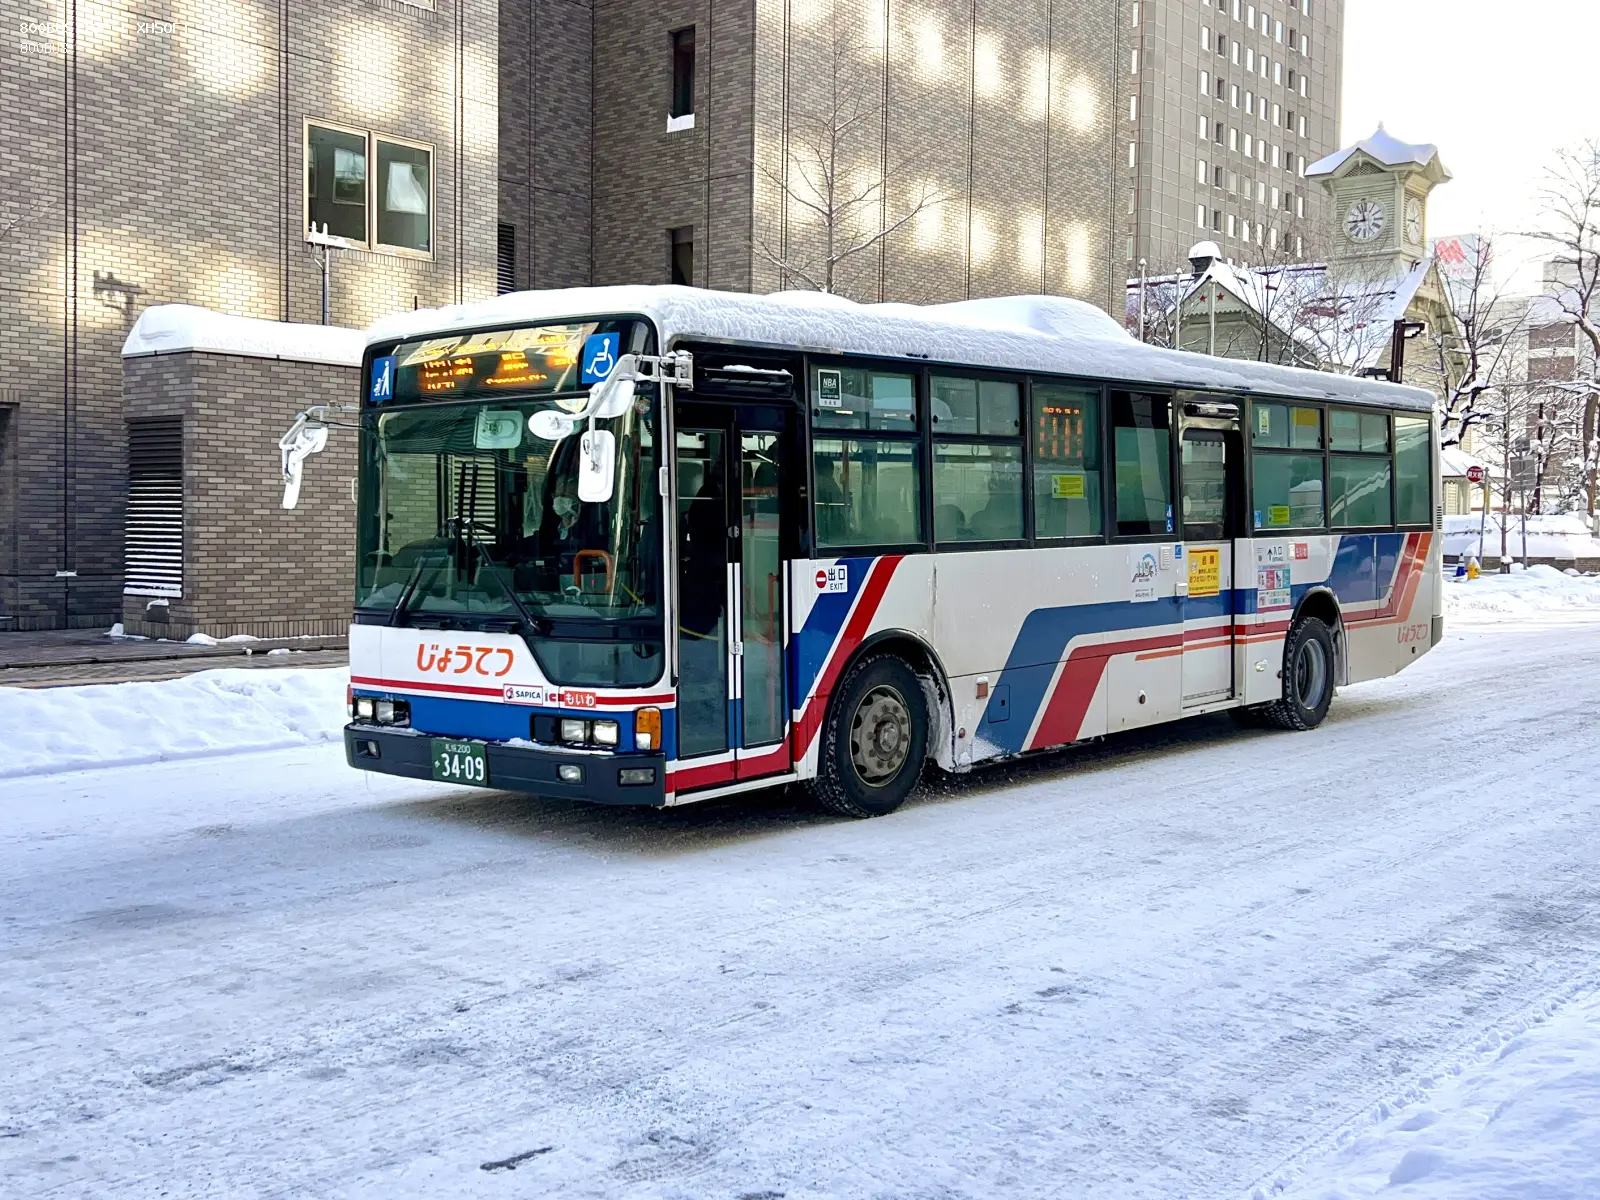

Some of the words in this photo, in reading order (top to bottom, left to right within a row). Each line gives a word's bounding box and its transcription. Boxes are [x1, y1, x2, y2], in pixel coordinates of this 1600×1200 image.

[828, 568, 846, 581] 出口
[830, 583, 844, 591] EXIT
[416, 643, 514, 677] じょうてつ
[515, 690, 541, 699] SAPICA
[565, 692, 595, 706] もいわ
[440, 752, 484, 781] 34-09
